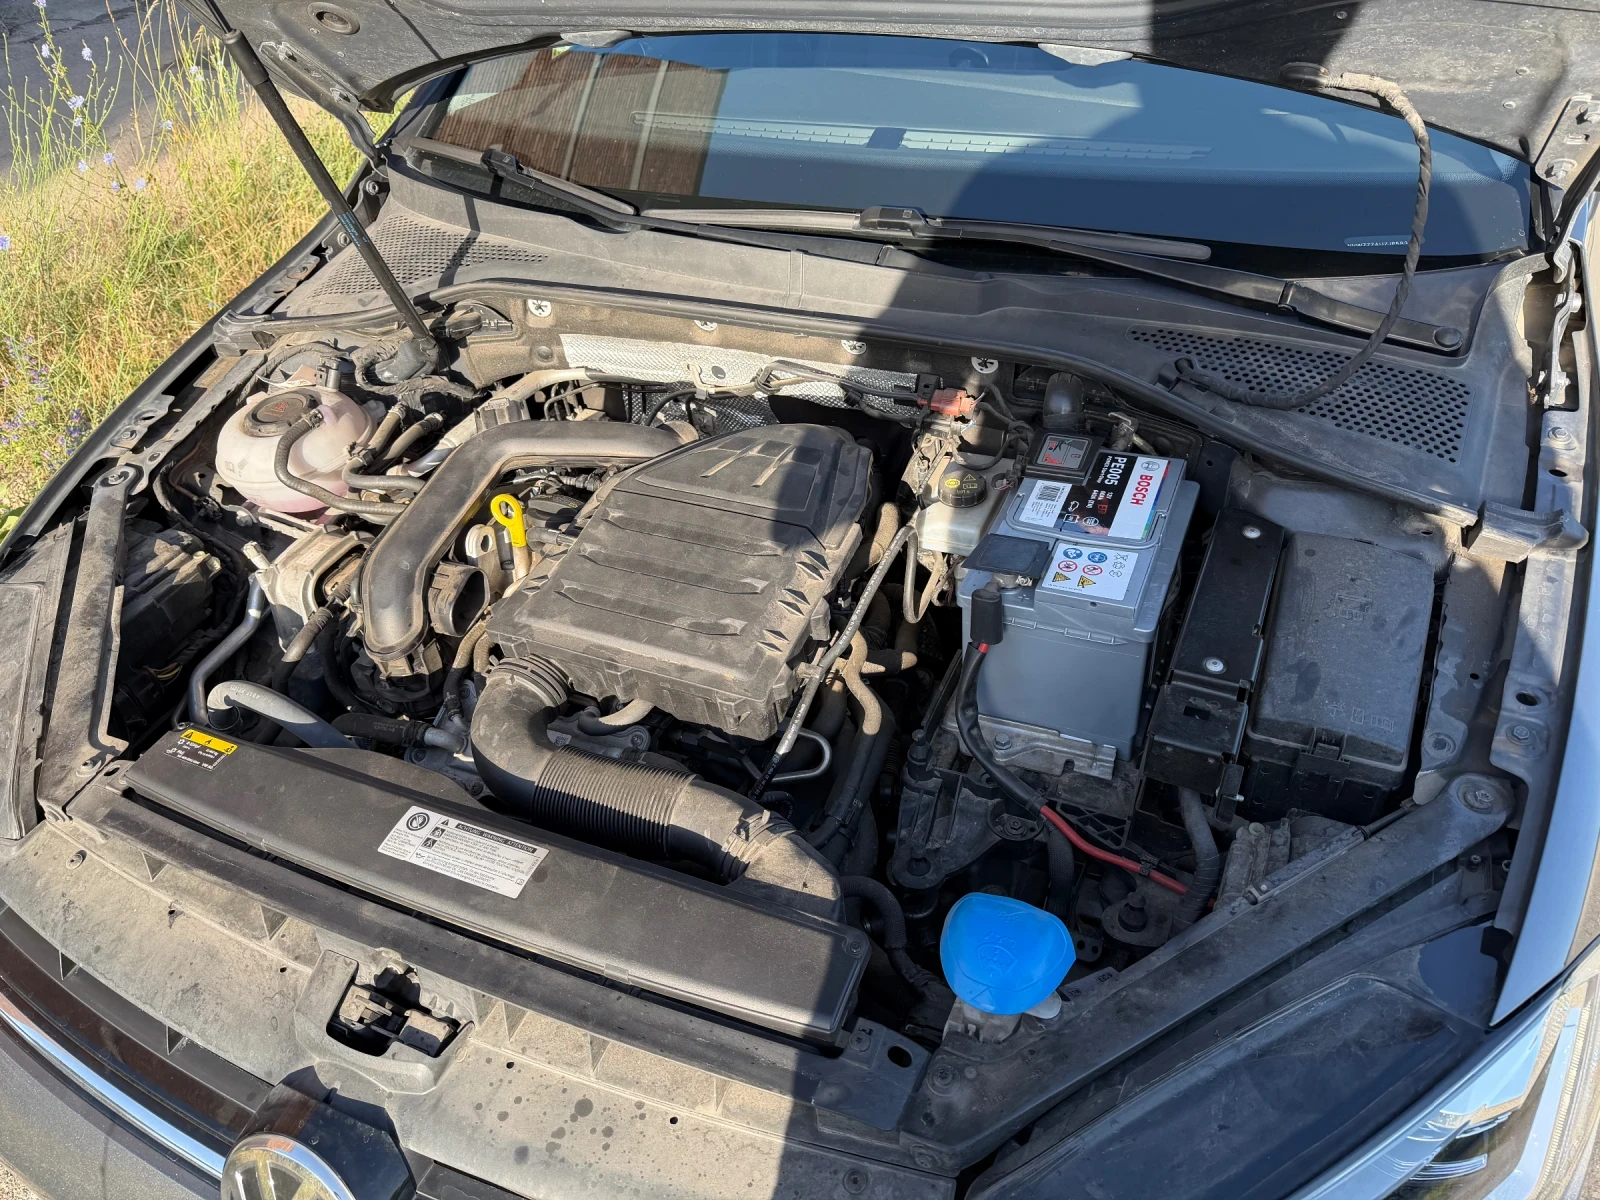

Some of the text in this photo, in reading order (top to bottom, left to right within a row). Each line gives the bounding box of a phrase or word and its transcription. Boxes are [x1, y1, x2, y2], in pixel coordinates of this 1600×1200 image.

[1105, 456, 1127, 485] PE005
[1130, 474, 1153, 505] BOSCH
[458, 824, 534, 853] ACHTUNG WARNING ATTENTION
